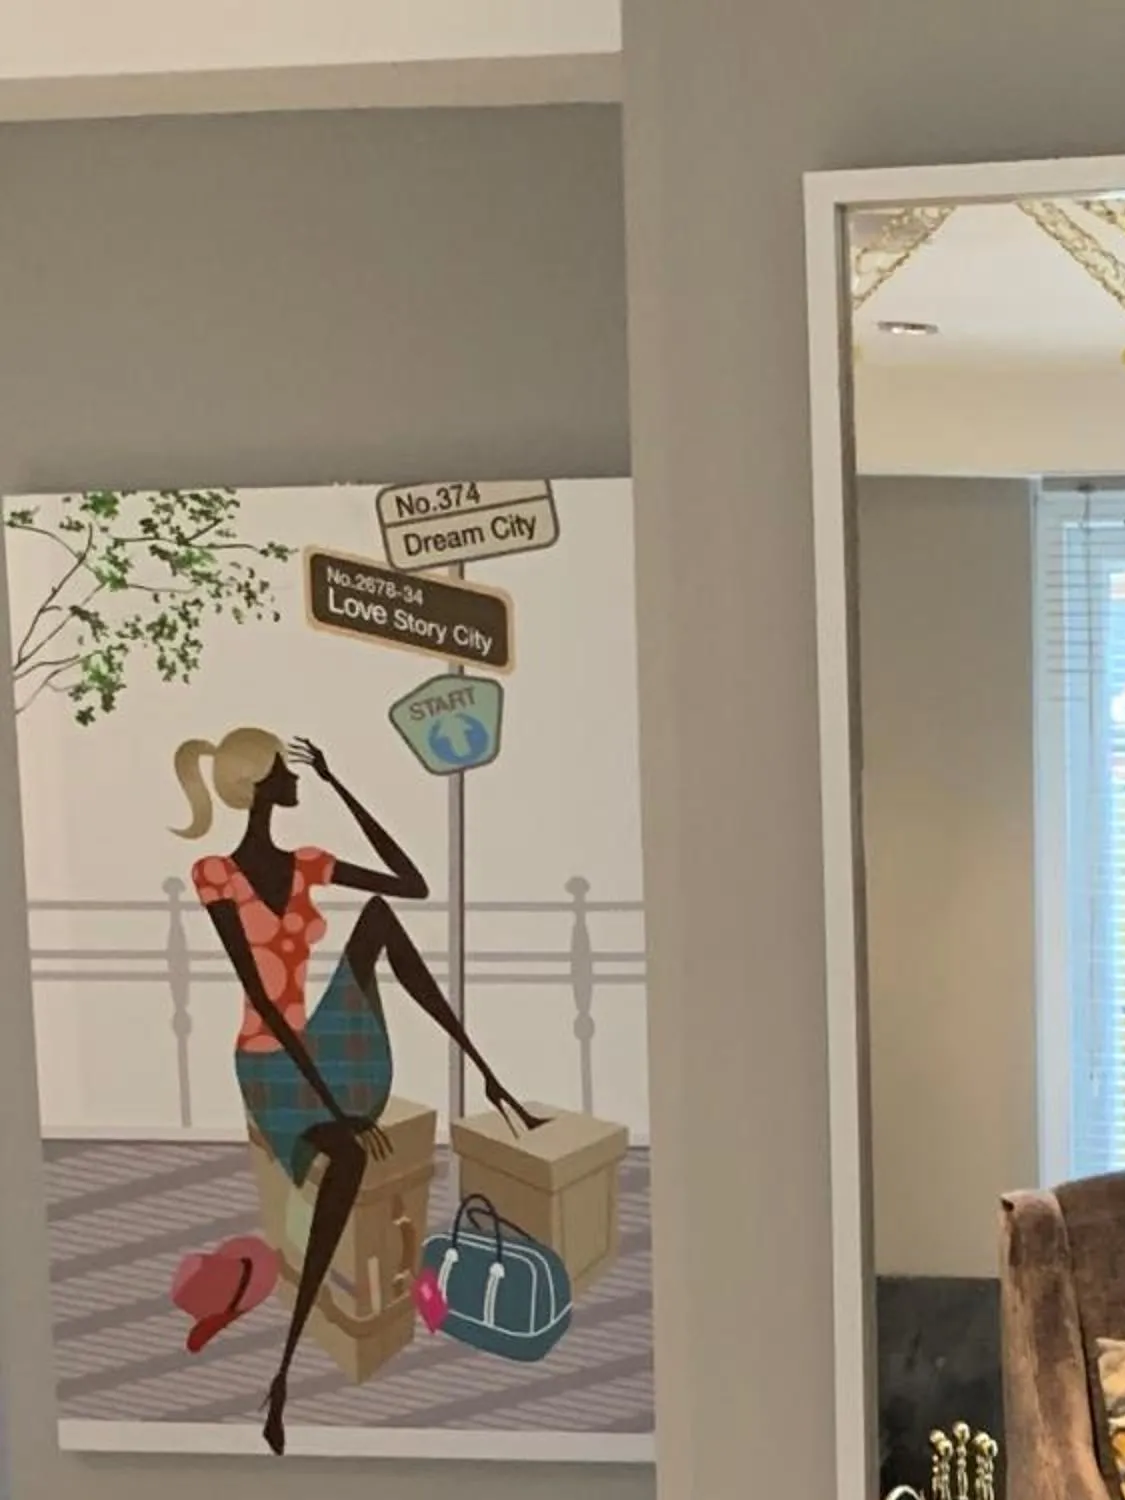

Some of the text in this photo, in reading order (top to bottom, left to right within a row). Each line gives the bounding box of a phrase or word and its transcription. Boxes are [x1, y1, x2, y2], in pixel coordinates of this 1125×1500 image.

[395, 482, 481, 518] No.374
[403, 514, 537, 556] Dream City
[328, 587, 493, 656] Love Story City
[408, 686, 477, 722] START
